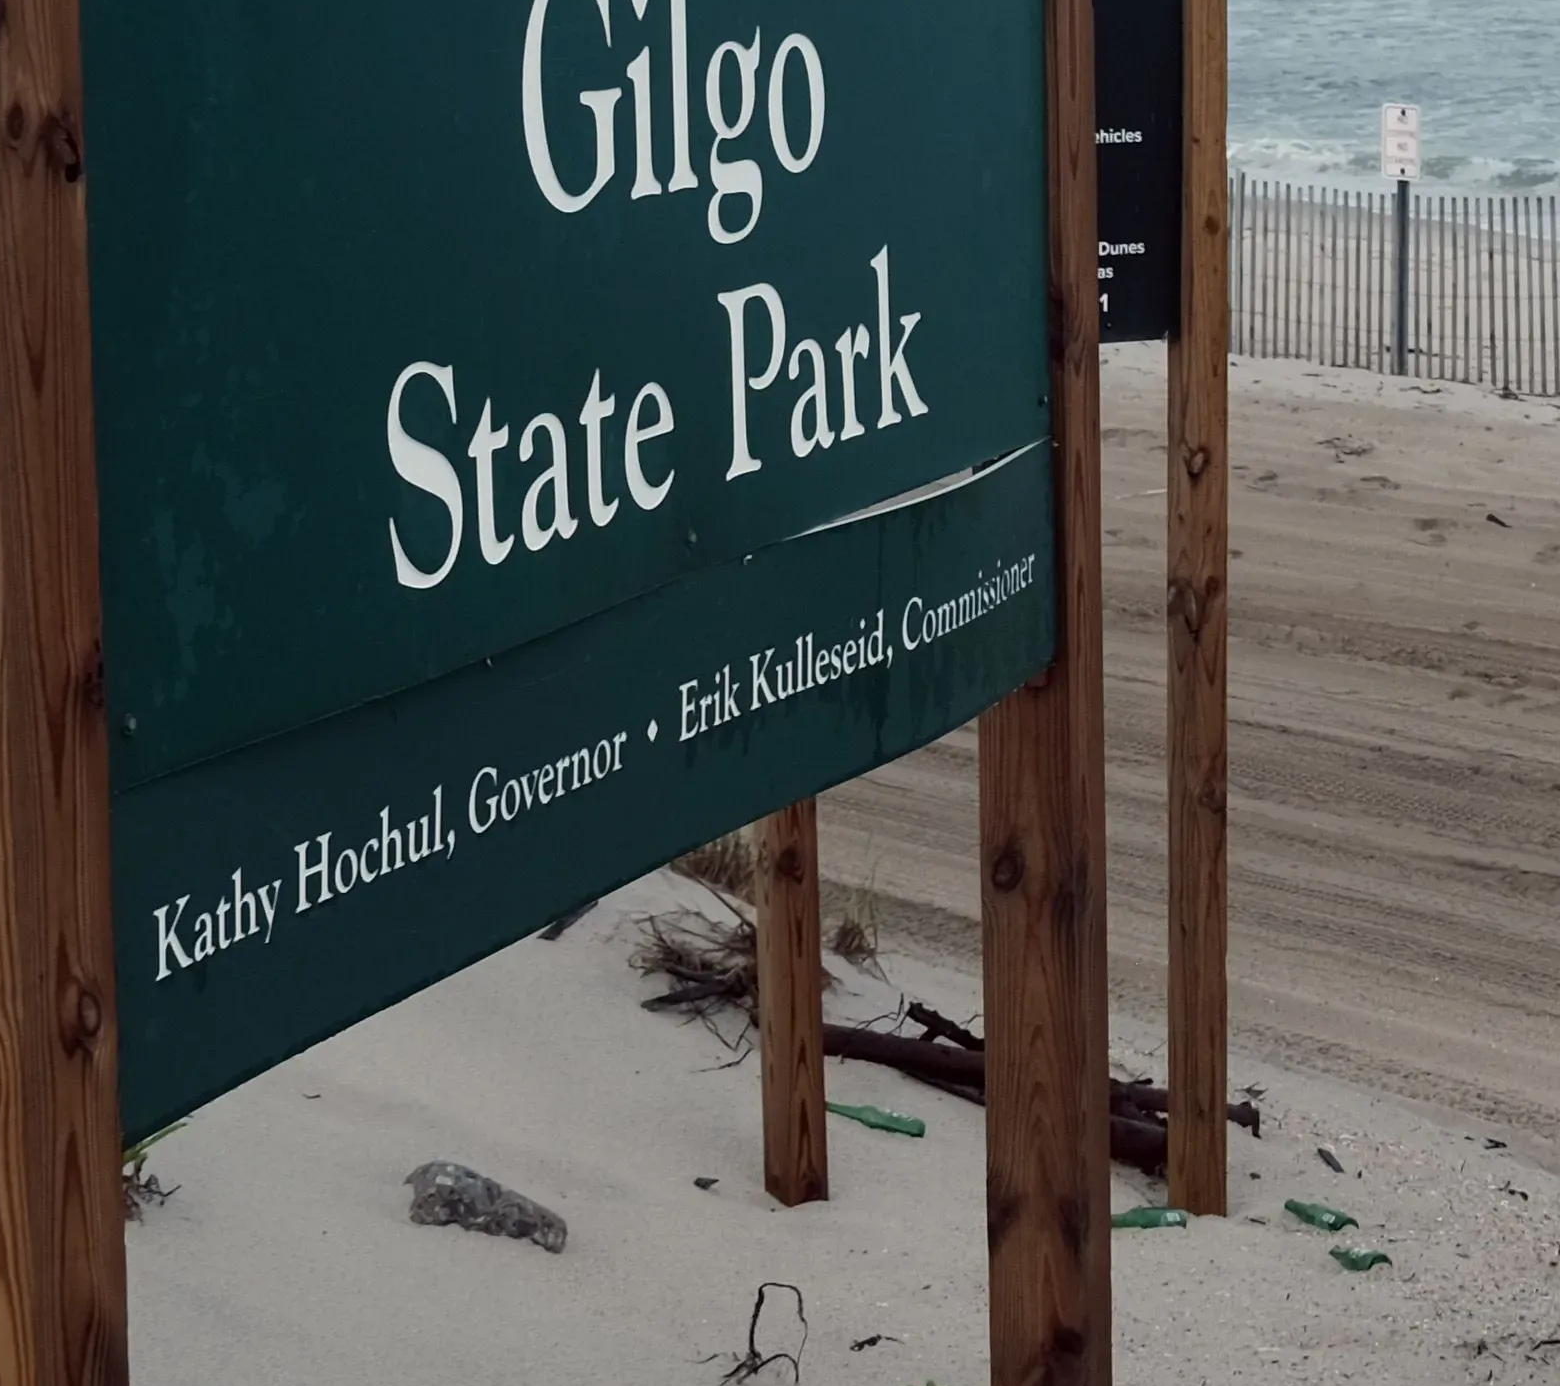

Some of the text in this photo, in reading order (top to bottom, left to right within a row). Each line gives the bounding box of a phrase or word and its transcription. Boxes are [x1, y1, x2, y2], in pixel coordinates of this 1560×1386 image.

[386, 243, 930, 590] State Park
[1098, 241, 1145, 257] Dunes
[151, 551, 1037, 984] Kathy Hochul, Governor Erik Kulleseid, Commissioner
